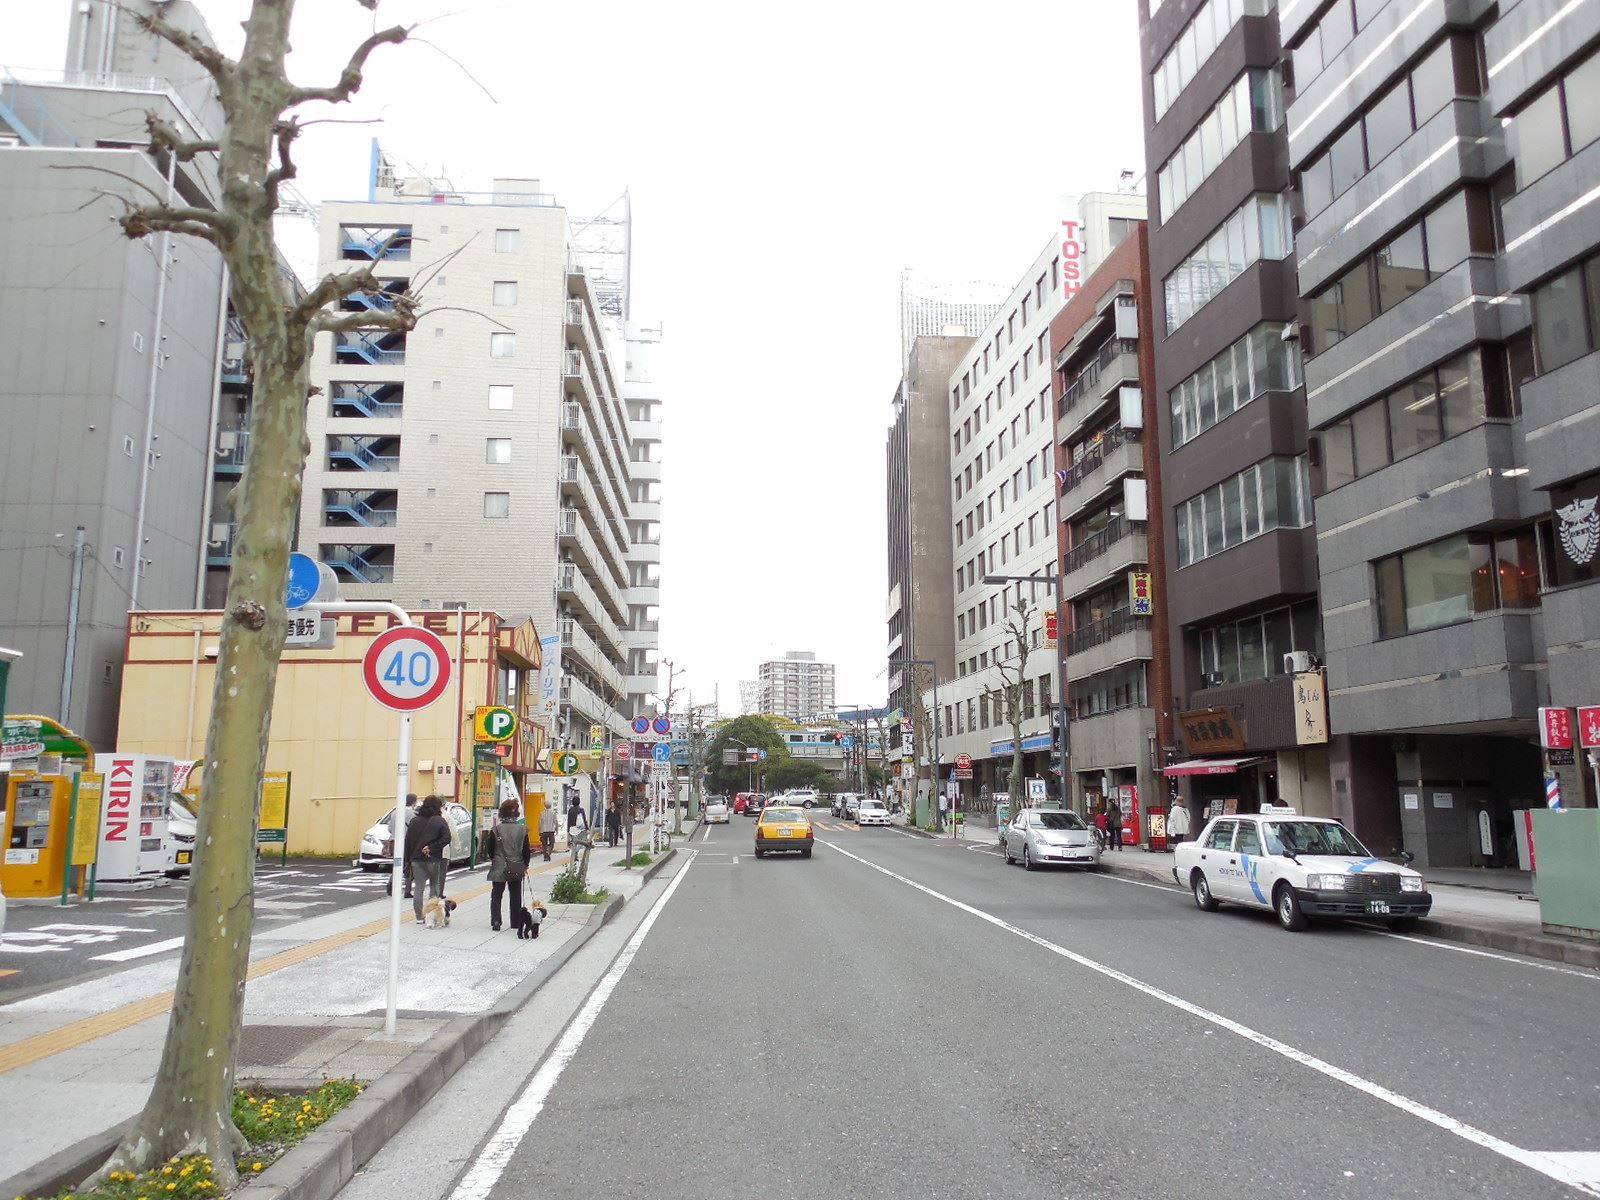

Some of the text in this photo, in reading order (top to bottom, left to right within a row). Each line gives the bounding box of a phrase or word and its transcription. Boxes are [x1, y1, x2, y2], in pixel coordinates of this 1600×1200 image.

[384, 651, 431, 686] 40
[493, 714, 510, 734] P
[105, 760, 134, 841] KIRIN
